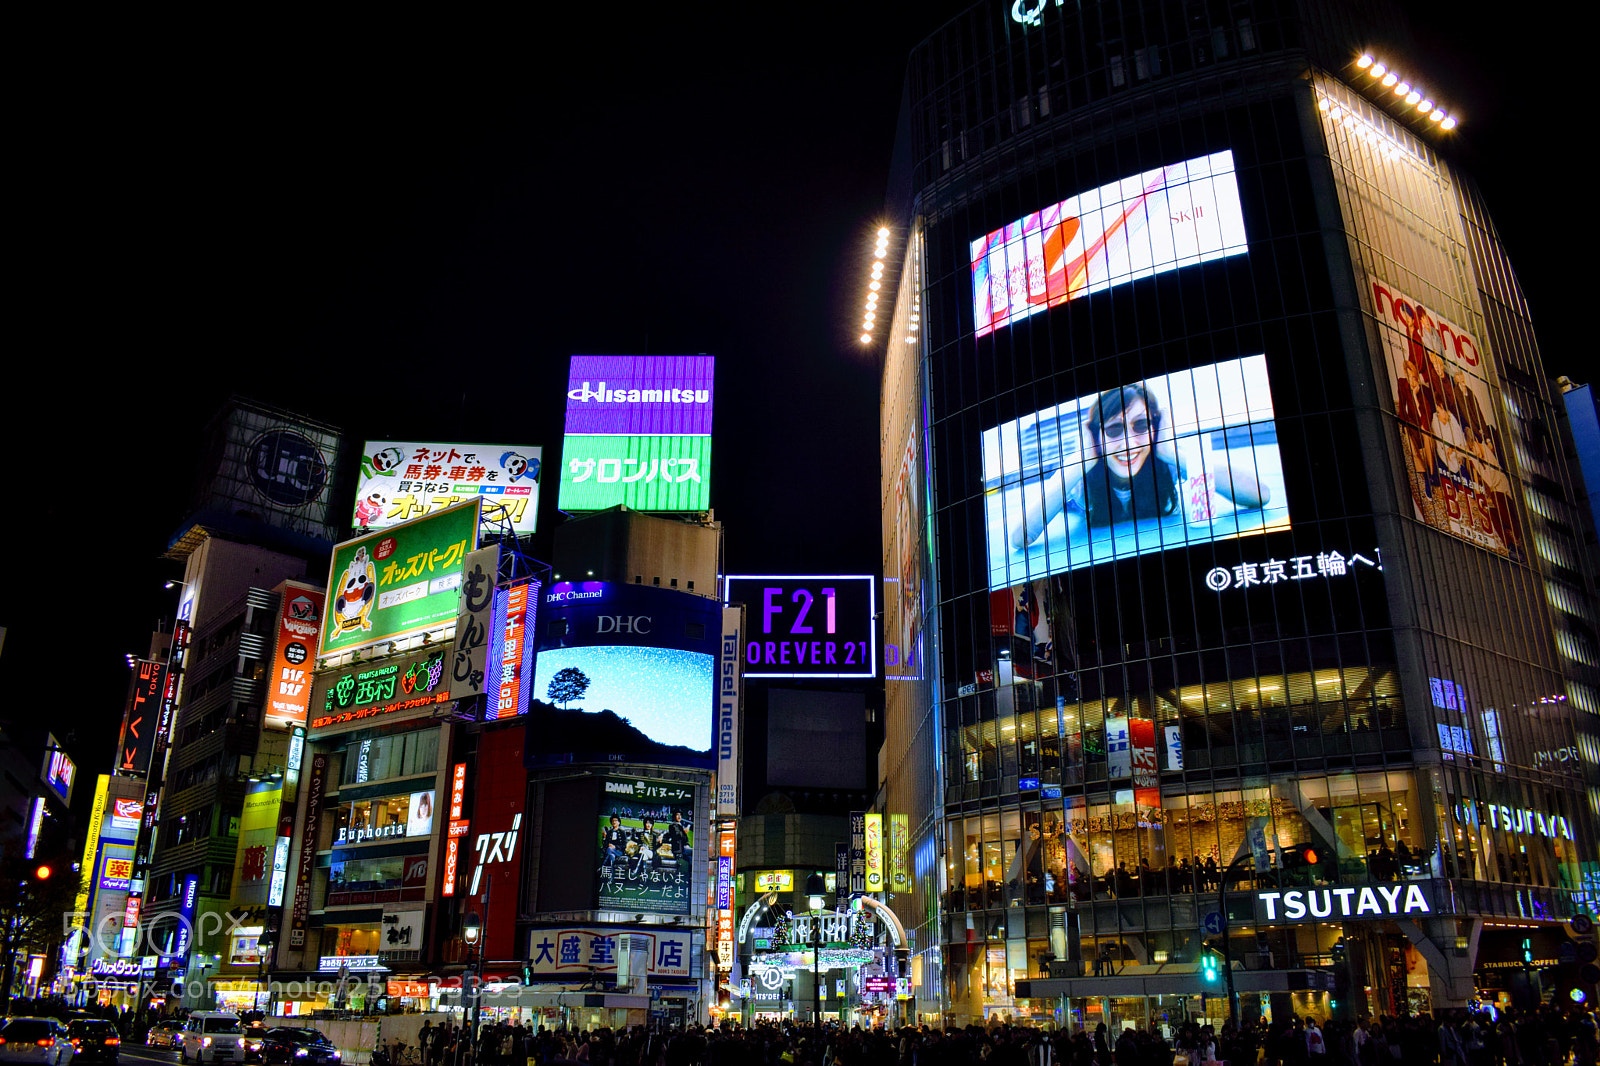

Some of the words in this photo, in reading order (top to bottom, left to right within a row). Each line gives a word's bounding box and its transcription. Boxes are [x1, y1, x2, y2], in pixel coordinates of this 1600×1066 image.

[567, 382, 710, 404] Hisamitsu
[403, 464, 499, 483] 馬券・車券を
[568, 457, 702, 483] サロンパス
[397, 480, 450, 494] 買うなら
[1440, 475, 1495, 537] BTS
[379, 539, 467, 587] オッズパーク!
[546, 593, 565, 604] DHC
[567, 589, 603, 602] Channel
[597, 615, 653, 635] DHC
[722, 629, 739, 697] Taisei
[746, 641, 838, 665] OREVER
[148, 663, 161, 697] TOKYO
[355, 675, 397, 705] 西村
[721, 703, 733, 761] neon
[605, 782, 634, 795] DMM
[647, 787, 692, 800] バヌーシー
[339, 820, 404, 843] Euphoria
[1488, 803, 1572, 841] TSUTAYA
[852, 816, 866, 892] 洋服の青山
[109, 859, 131, 879] 薬
[598, 880, 690, 900] バヌーシーだよ!
[1258, 884, 1431, 921] TSUTAYA
[534, 936, 684, 969] 大盛堂店
